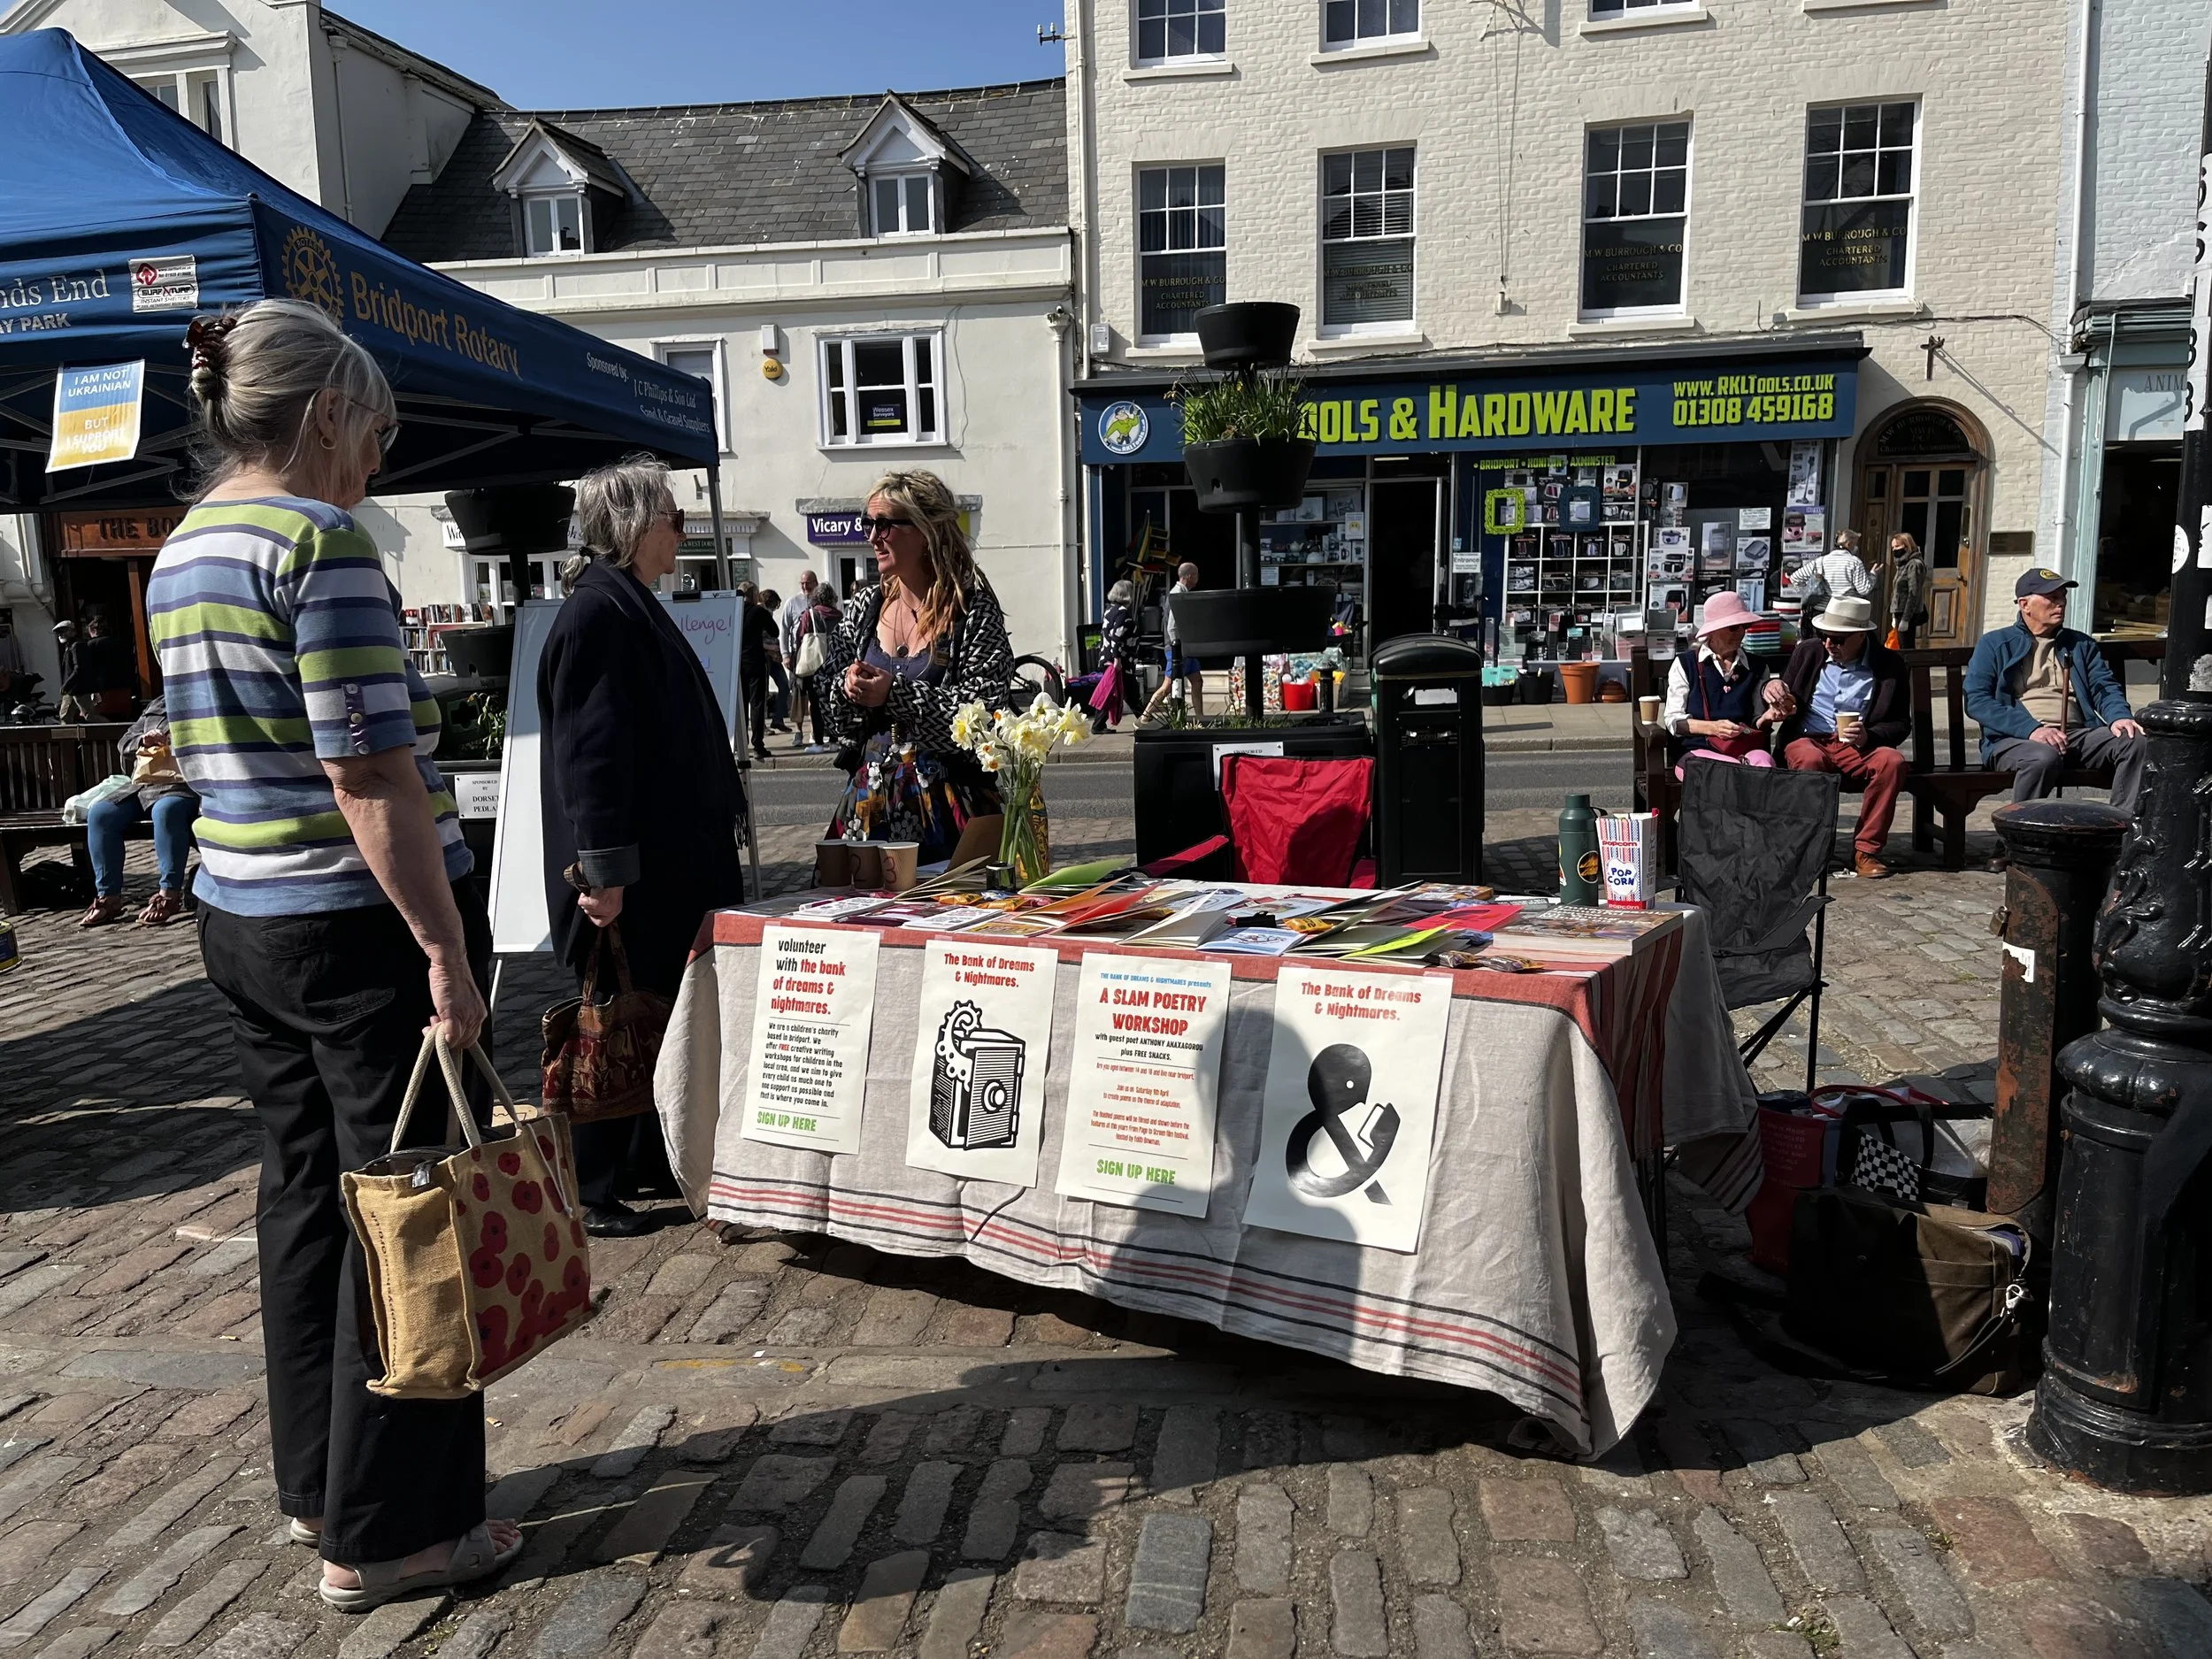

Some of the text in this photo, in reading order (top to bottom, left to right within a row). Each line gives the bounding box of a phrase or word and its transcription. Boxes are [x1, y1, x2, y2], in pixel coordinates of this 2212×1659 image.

[1824, 229, 1879, 241] BURROUGH
[1892, 227, 1906, 235] CO
[1606, 246, 1656, 257] BURROUGH
[1826, 245, 1881, 255] CHARTERED
[1607, 262, 1658, 272] CHARTERED
[1820, 256, 1887, 266] ACCOUNTANTS
[1159, 277, 1202, 286] BURROUGH
[1601, 271, 1663, 281] ACCOUNTANTS
[48, 269, 110, 303] End
[1161, 291, 1204, 300] CHARTERED
[20, 312, 72, 332] PARK
[350, 272, 523, 380] Bridport Rotary
[587, 352, 618, 377] Sponsored
[81, 373, 99, 384] AM
[104, 370, 127, 380] NOT
[2144, 374, 2185, 392] ANIM
[68, 380, 131, 396] UKRAINIAN
[639, 381, 643, 395] C
[644, 382, 667, 403] Phillips
[669, 389, 673, 401] &
[675, 390, 686, 405] Son
[1389, 398, 1417, 439] &
[1429, 385, 1636, 439] HARDWARE
[1673, 393, 1833, 426] 01308 459168
[85, 418, 109, 430] BUT
[73, 428, 124, 443] SUPPORT
[81, 442, 106, 454] YOU
[1480, 455, 1615, 470] BRIDPORT HONITON AXMINSTER
[96, 518, 140, 540] THE
[812, 518, 862, 535] Vicary &
[1608, 876, 1634, 886] CORN
[779, 939, 826, 954] volunteer
[776, 957, 846, 975] with the bank
[945, 953, 1034, 972] The Bank of Dreams
[773, 976, 834, 995] of dreams &
[956, 971, 1018, 987] & Nightmares.
[1100, 987, 1207, 1012] A SLAM POETRY
[1302, 982, 1421, 1003] The Bank of Dreams
[772, 996, 831, 1015] nightmares.
[1315, 1002, 1400, 1020] & Nightmares.
[1113, 1013, 1188, 1035] WORKSHOP
[789, 1034, 810, 1044] Bridport.
[818, 1027, 839, 1038] charity
[791, 1045, 812, 1054] creative
[814, 1048, 834, 1057] writing
[1166, 1041, 1202, 1051] ANAXAGOROU
[765, 1053, 791, 1062] workshops
[803, 1056, 825, 1065] children
[830, 1070, 842, 1079] give
[757, 1111, 817, 1132] SIGN UP HERE
[1096, 1159, 1175, 1185] SIGN UP HERE
